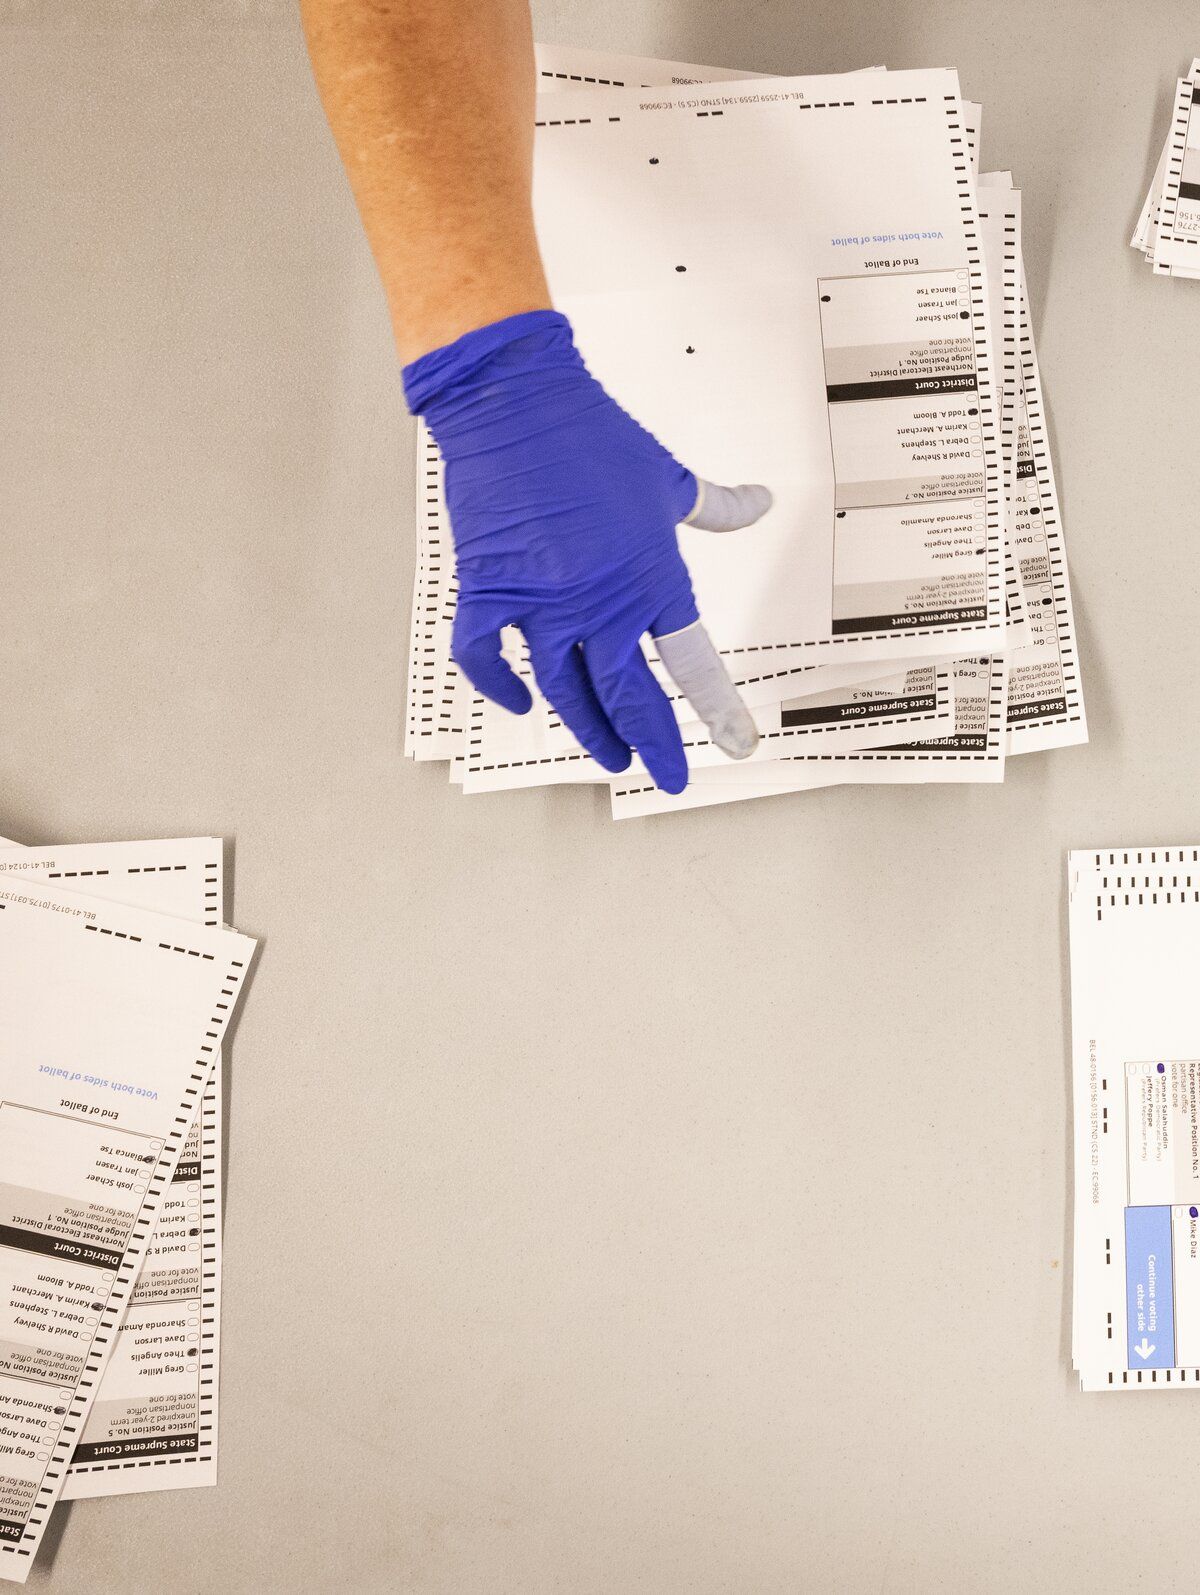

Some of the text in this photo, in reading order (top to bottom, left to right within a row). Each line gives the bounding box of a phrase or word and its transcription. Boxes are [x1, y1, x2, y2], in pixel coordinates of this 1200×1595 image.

[791, 92, 804, 100] BEL
[686, 99, 700, 108] (CS
[700, 98, 721, 107] STND
[872, 234, 896, 243] sides
[898, 233, 921, 242] both
[921, 231, 944, 239] Vote
[831, 237, 859, 247] ballot
[864, 260, 891, 269] Ballot
[902, 258, 919, 267] End
[915, 312, 959, 322] Josh Schaer
[869, 363, 973, 378] Northeast Electoral District
[915, 378, 975, 390] District Court
[913, 411, 938, 420] Bloom
[947, 409, 967, 418] Todd
[892, 609, 985, 626] State Supreme Court
[840, 698, 934, 716] State Supreme Court
[51, 903, 97, 921] BEL 41-0175
[38, 1064, 69, 1080] ballot
[83, 1075, 109, 1088] sides
[110, 1082, 135, 1095] both
[135, 1088, 158, 1100] Vote
[53, 1242, 120, 1265] District Court
[1190, 1240, 1198, 1259] Diaz
[12, 1284, 54, 1301] Merchant
[1147, 1254, 1158, 1332] Continue voting
[64, 1296, 91, 1309] Karim
[1136, 1283, 1146, 1332] other side
[138, 1364, 185, 1376] Greg Miller
[94, 1438, 196, 1456] State Supreme Court
